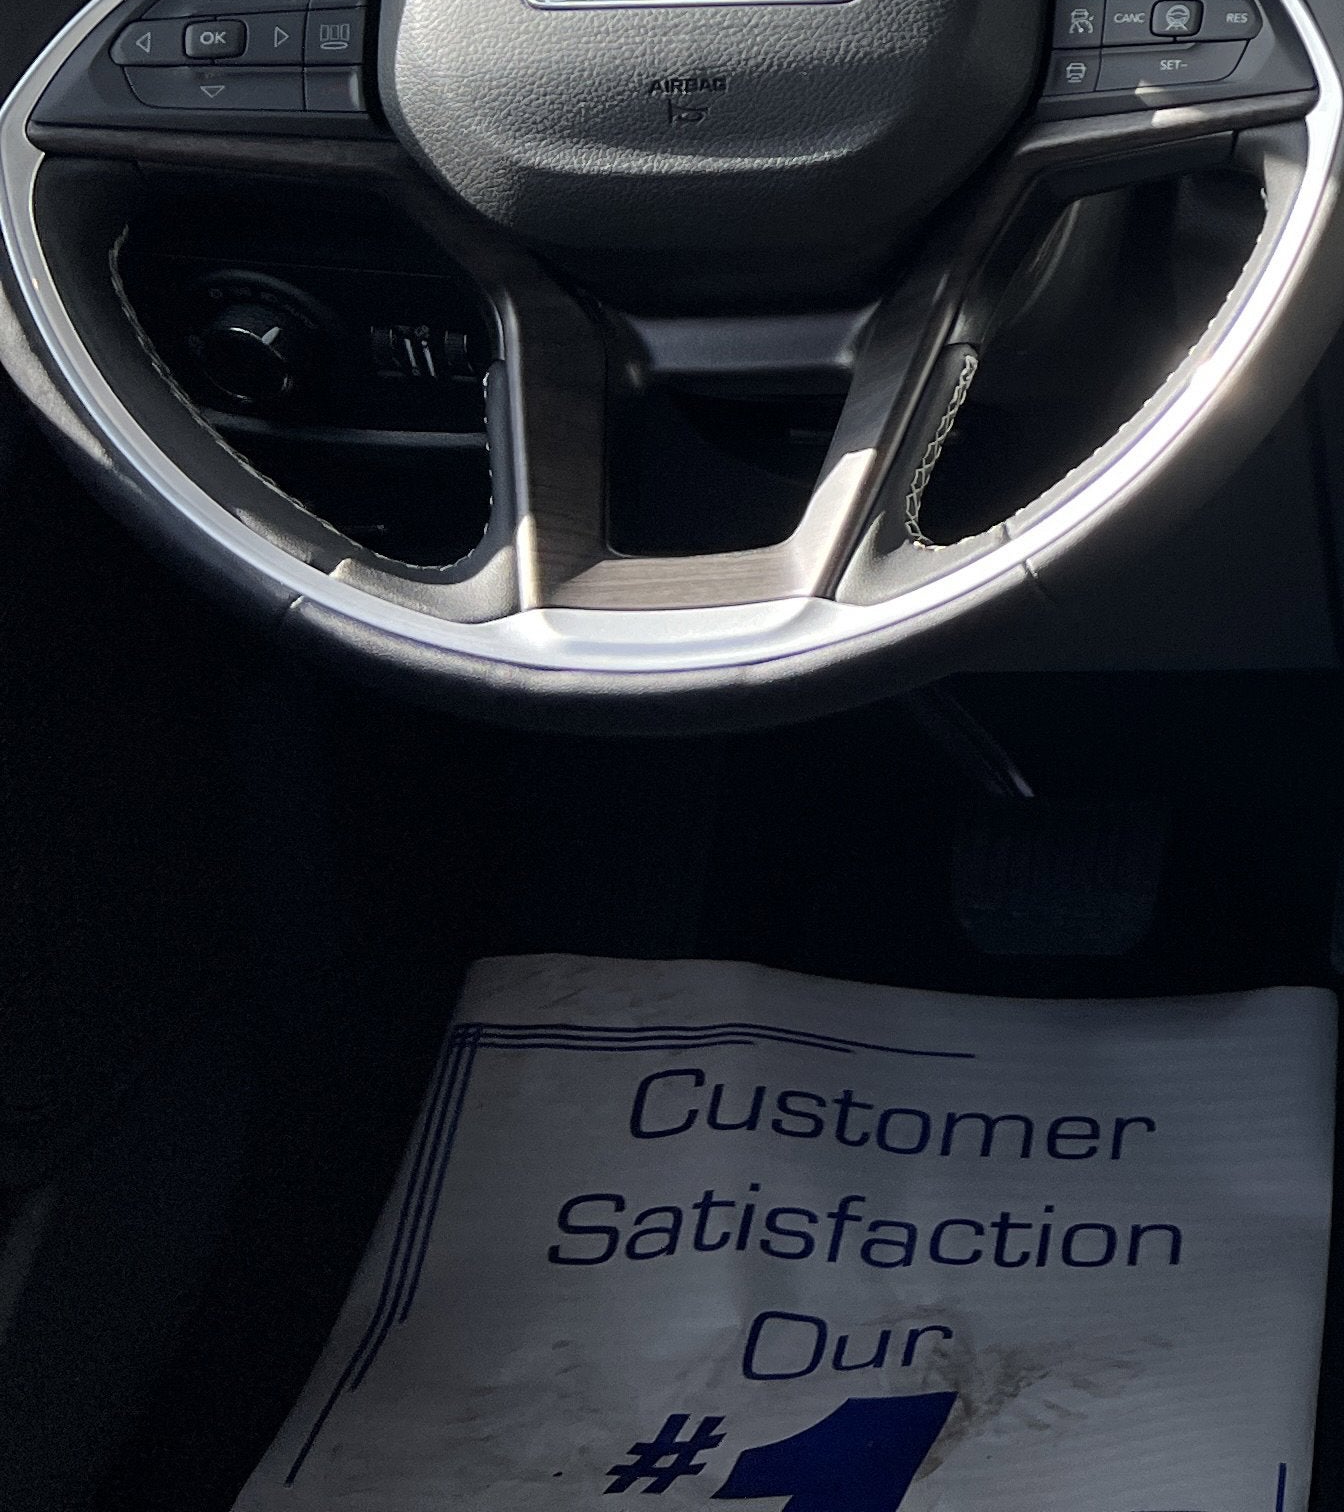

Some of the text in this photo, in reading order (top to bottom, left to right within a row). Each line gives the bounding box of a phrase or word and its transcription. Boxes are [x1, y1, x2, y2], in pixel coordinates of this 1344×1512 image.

[200, 31, 227, 45] OK
[1113, 12, 1146, 24] CANC
[1226, 13, 1248, 24] RES
[627, 1067, 1158, 1164] Customer
[546, 1182, 1185, 1270] Satisfaction
[741, 1309, 955, 1383] Our
